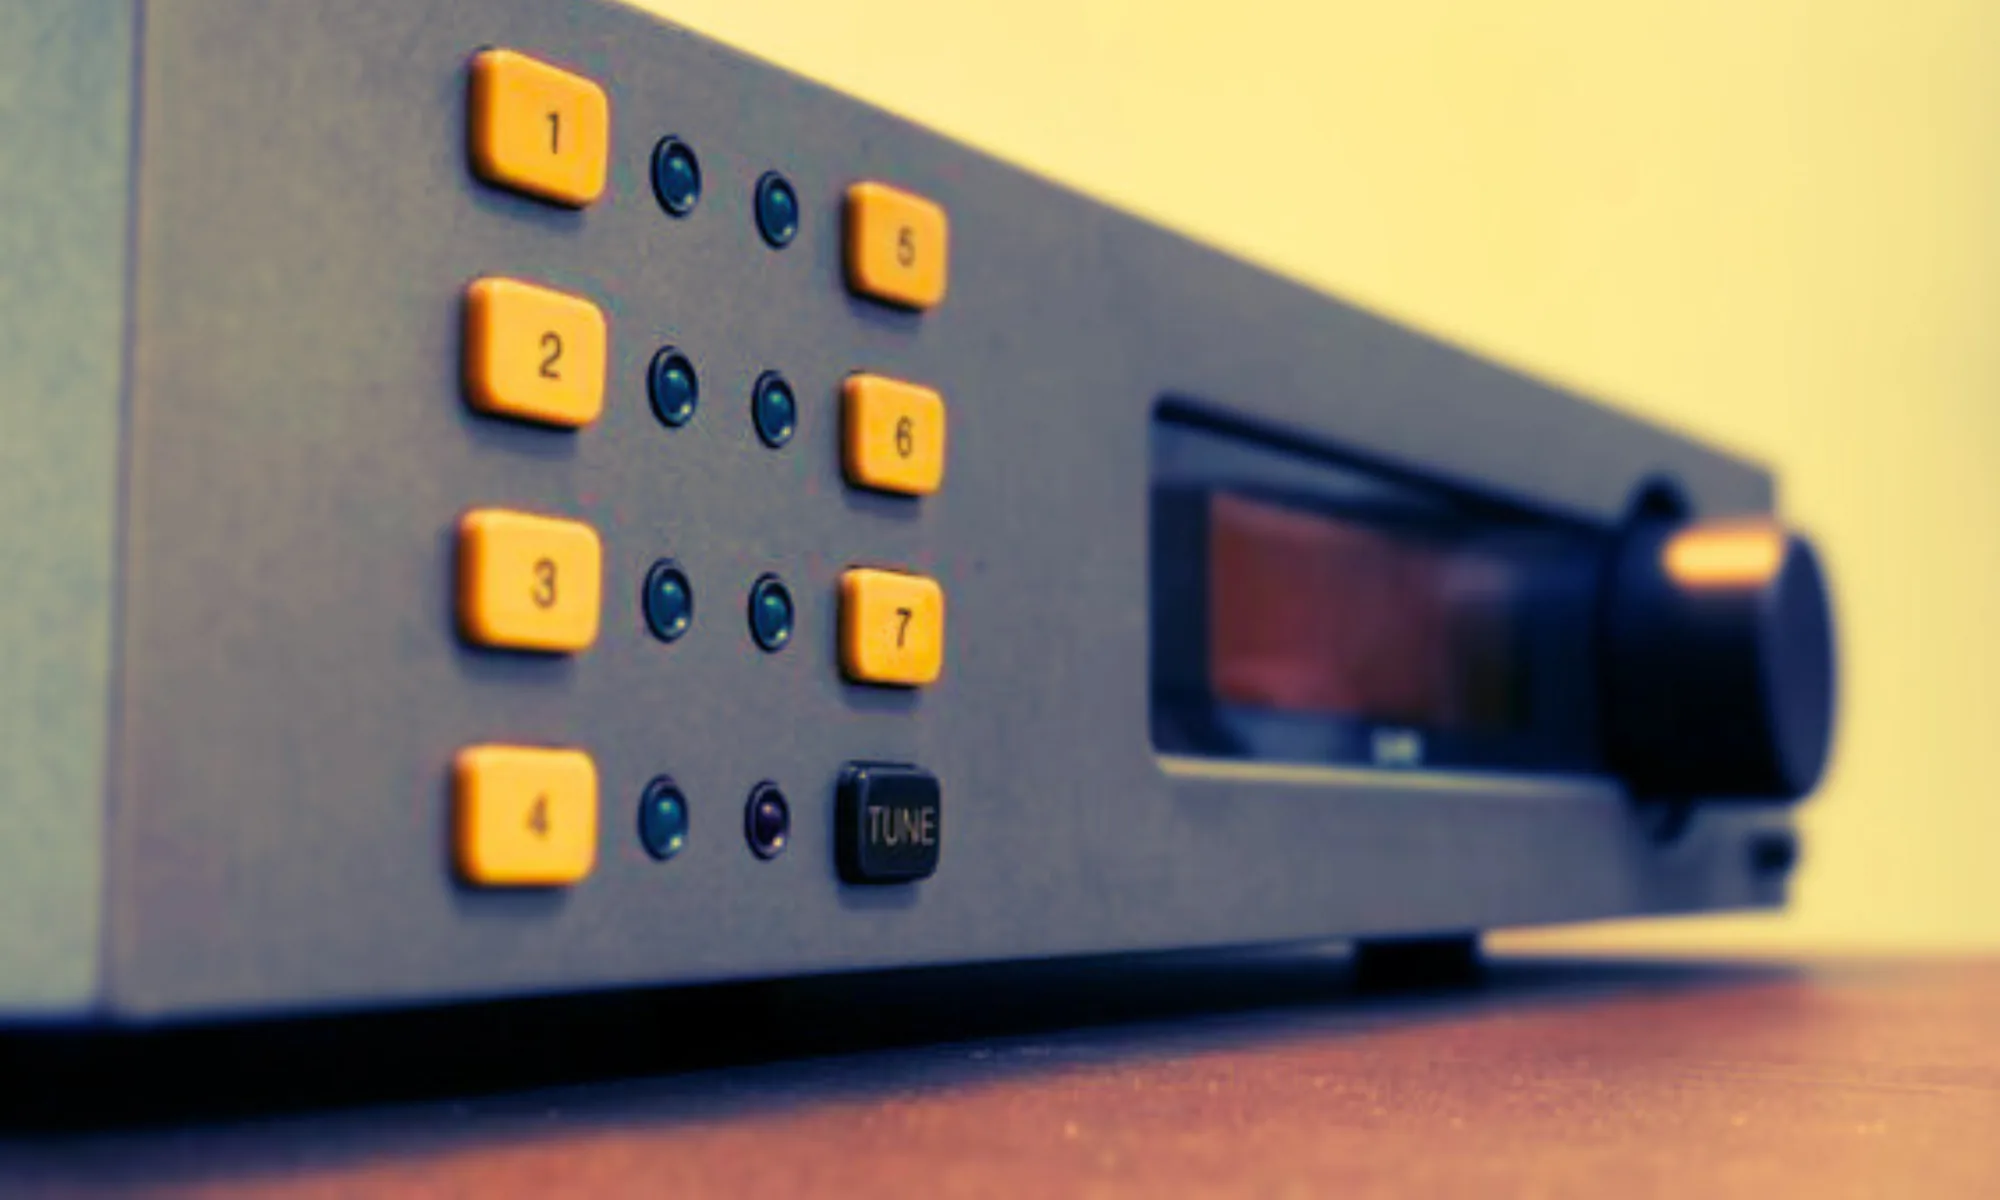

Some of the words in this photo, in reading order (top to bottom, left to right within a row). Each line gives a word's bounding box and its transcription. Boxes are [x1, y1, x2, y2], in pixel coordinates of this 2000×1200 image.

[545, 111, 560, 154] 1
[896, 227, 915, 267] 5
[538, 331, 563, 380] 2
[894, 416, 914, 457] 6
[532, 558, 557, 608] 3
[894, 607, 913, 650] 7
[525, 795, 550, 839] 4
[868, 805, 936, 847] TUNE
